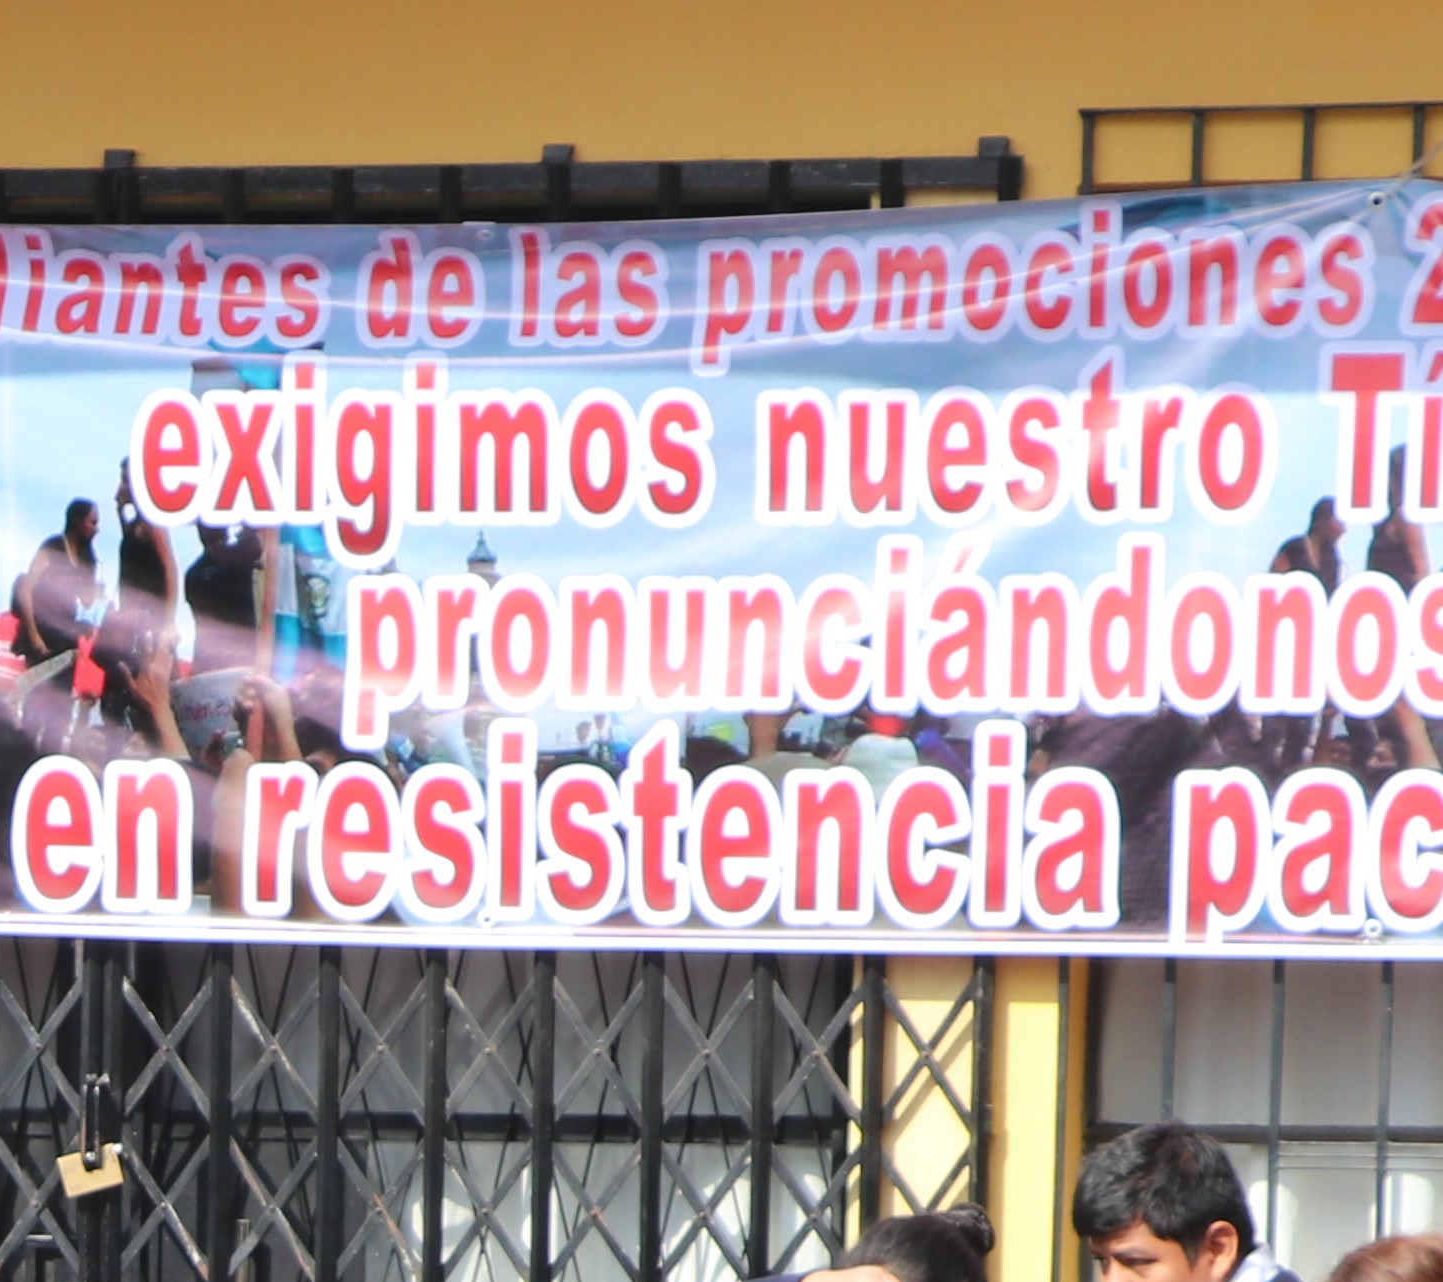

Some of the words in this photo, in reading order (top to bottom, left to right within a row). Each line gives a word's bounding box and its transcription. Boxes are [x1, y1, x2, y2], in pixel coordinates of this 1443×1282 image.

[369, 240, 472, 338] de
[523, 234, 655, 337] las
[705, 206, 1367, 368] promociones
[143, 363, 703, 556] exigimos
[769, 358, 1265, 514] nuestro
[27, 772, 177, 899] en
[249, 720, 1108, 918] resistencia
